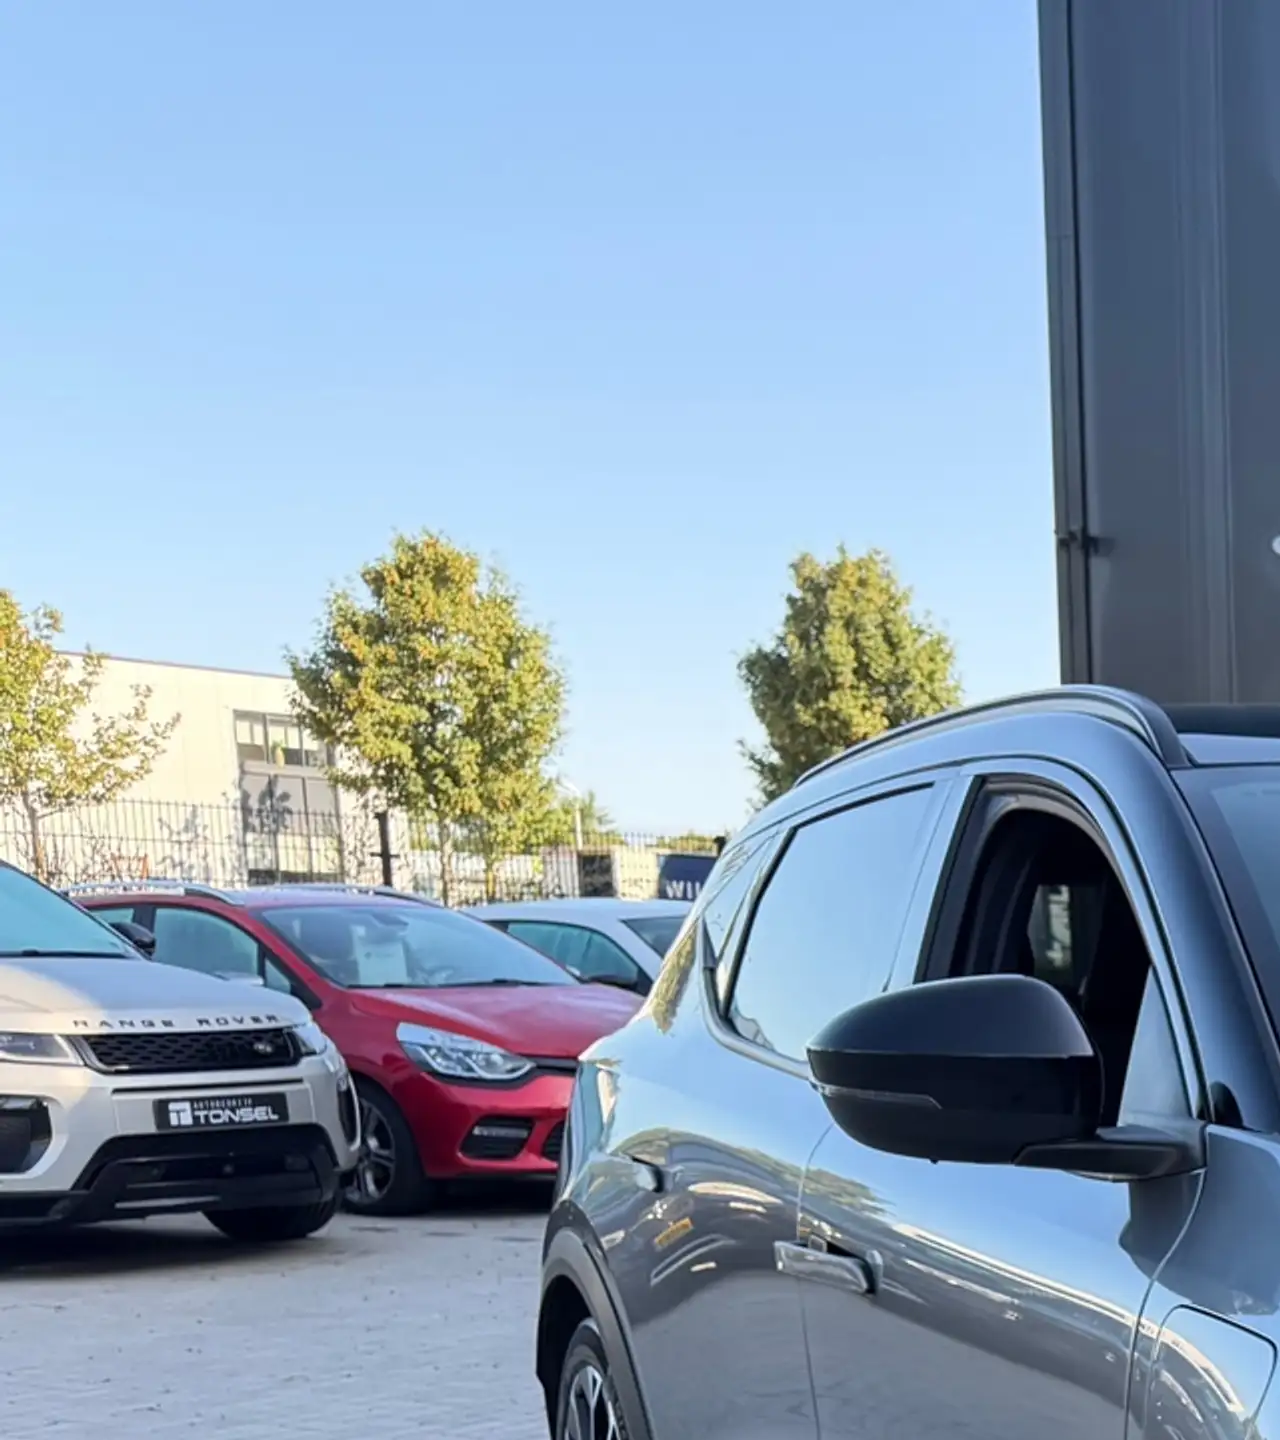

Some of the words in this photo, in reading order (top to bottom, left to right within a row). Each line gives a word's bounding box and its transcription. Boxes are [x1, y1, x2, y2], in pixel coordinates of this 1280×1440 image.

[73, 1018, 176, 1029] RANGE
[196, 1013, 280, 1027] ROVER
[194, 1105, 279, 1124] TONSEL
